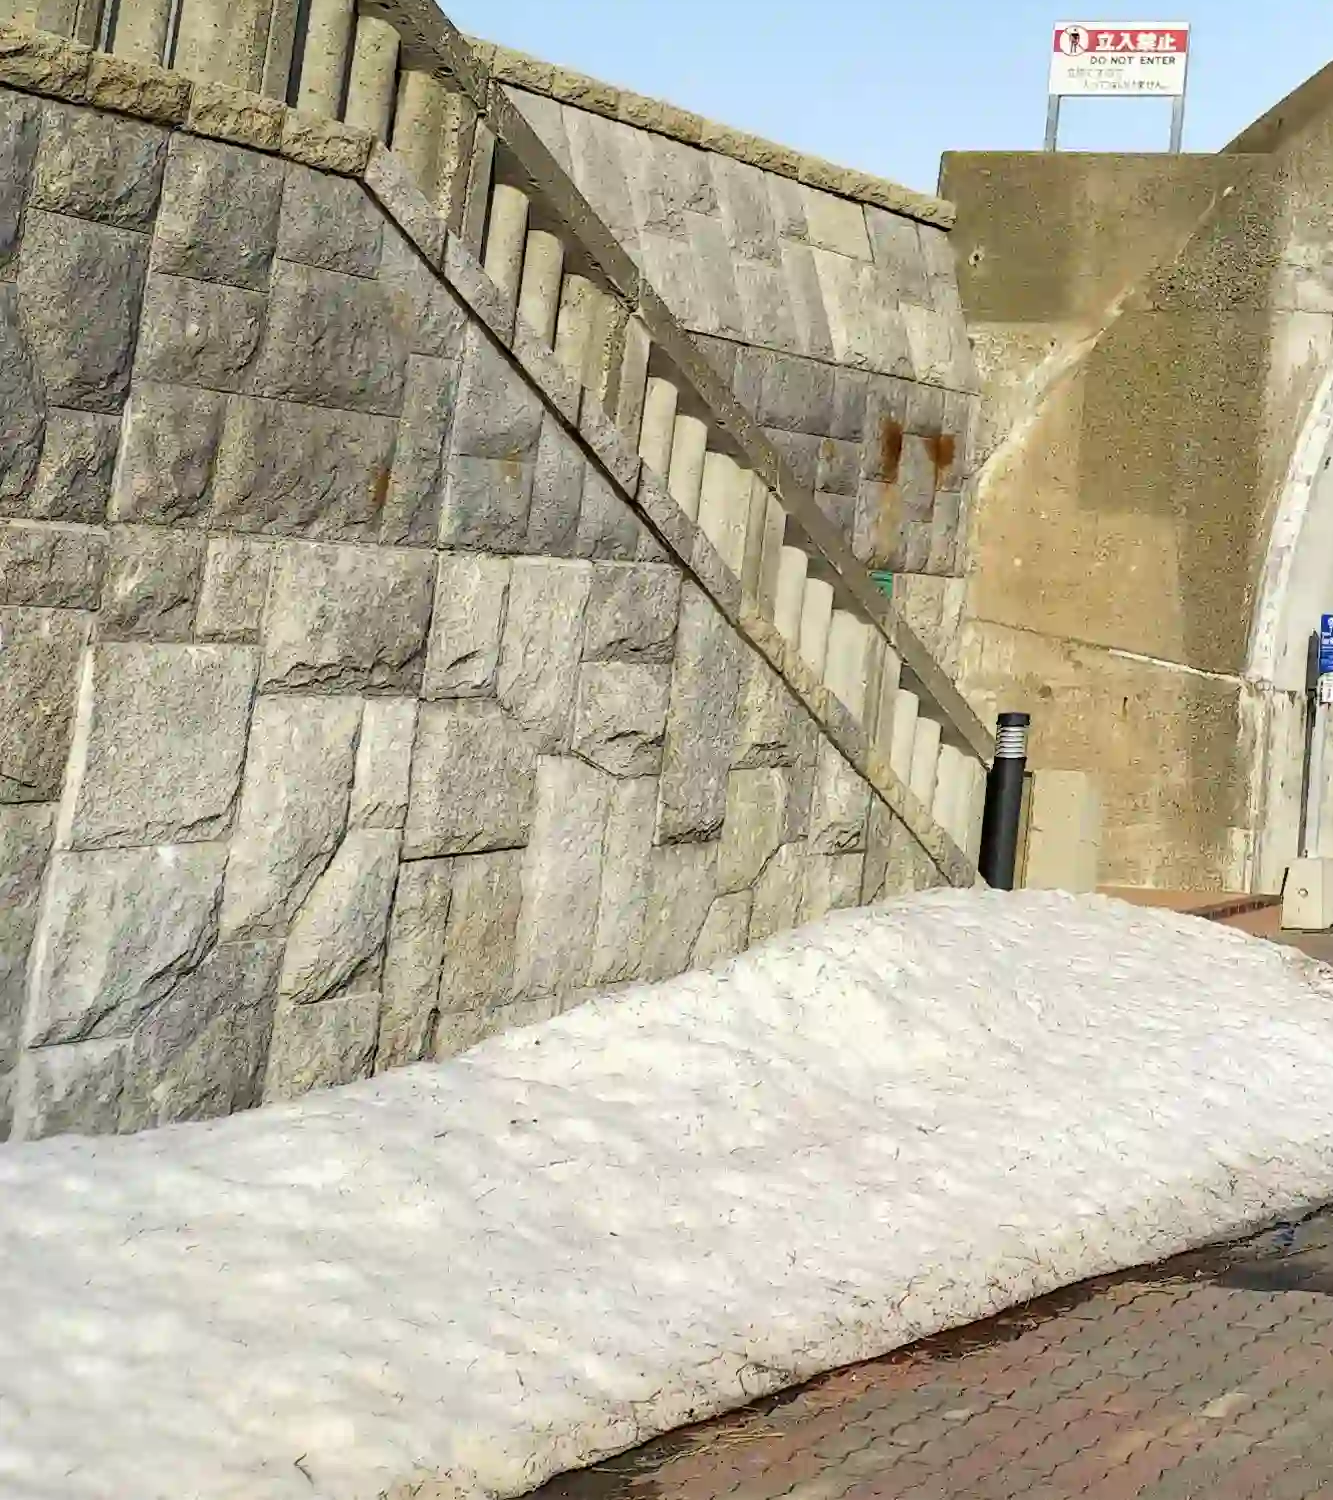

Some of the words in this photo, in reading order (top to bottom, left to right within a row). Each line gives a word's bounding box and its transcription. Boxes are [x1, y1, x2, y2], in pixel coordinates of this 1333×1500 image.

[1095, 31, 1177, 51] 立入禁止
[1090, 55, 1106, 65] DO
[1111, 55, 1134, 65] NOT
[1140, 55, 1176, 65] ENTER
